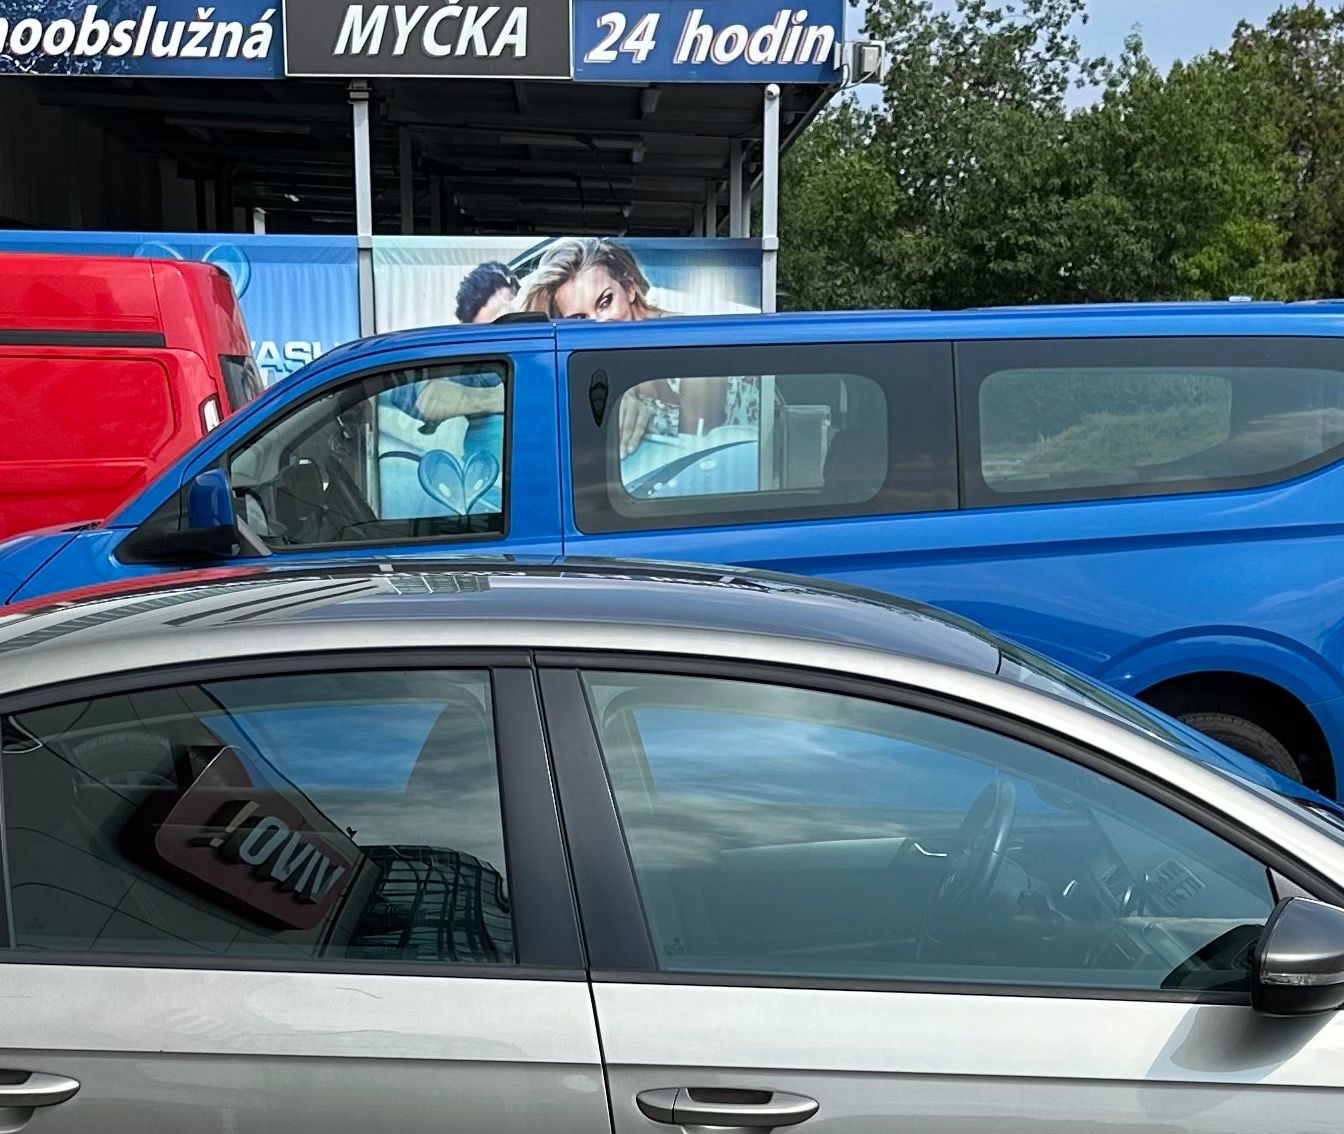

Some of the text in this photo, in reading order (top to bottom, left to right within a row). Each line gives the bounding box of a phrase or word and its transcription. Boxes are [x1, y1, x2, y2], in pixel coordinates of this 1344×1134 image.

[333, 0, 528, 58] MYČKA
[584, 8, 836, 65] 24 hodin
